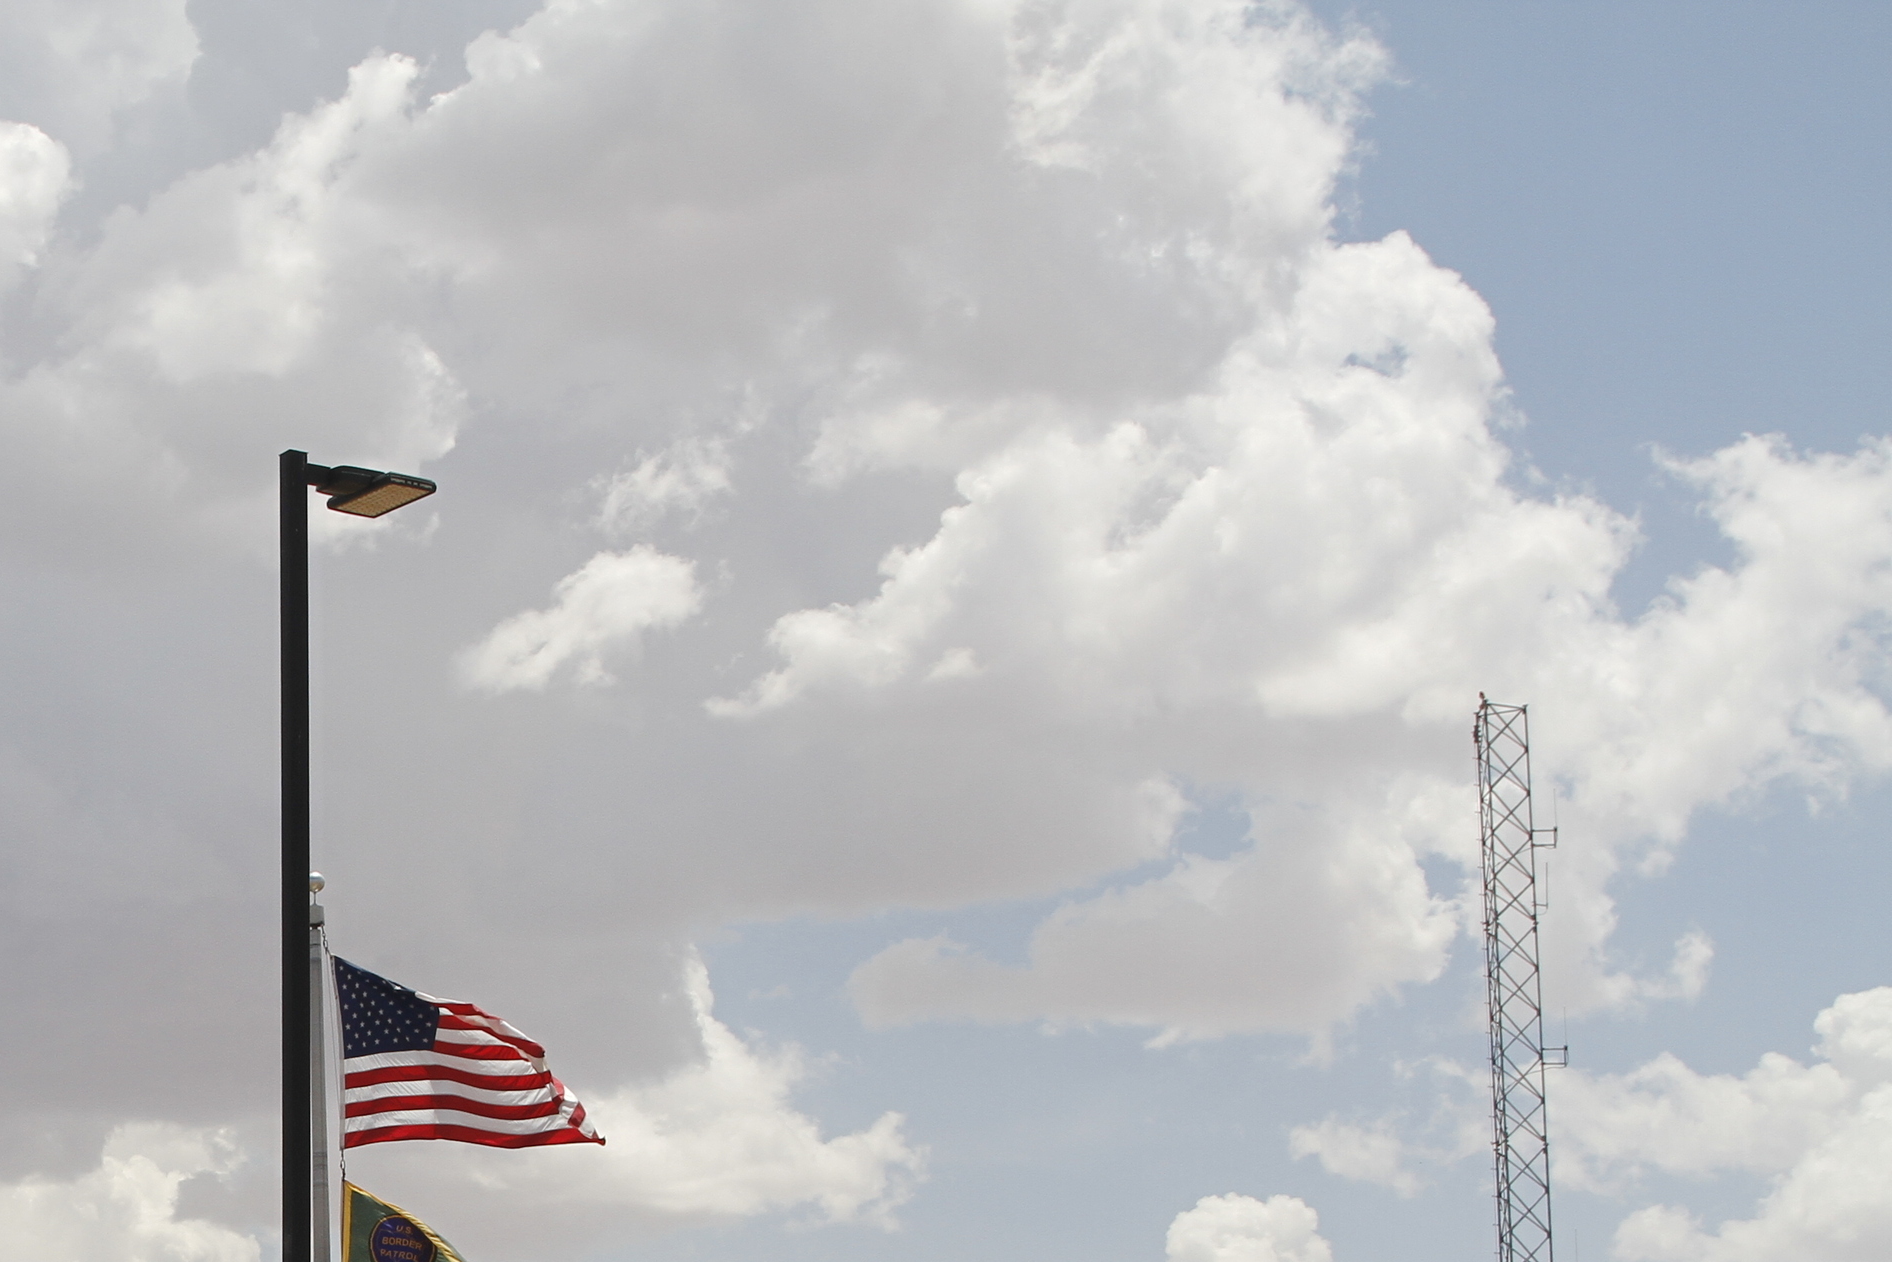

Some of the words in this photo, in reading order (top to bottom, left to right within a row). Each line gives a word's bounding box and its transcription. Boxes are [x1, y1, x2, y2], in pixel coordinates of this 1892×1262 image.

[396, 1225, 413, 1235] U.S.
[382, 1237, 422, 1250] BORDER
[380, 1249, 419, 1262] PATROL
